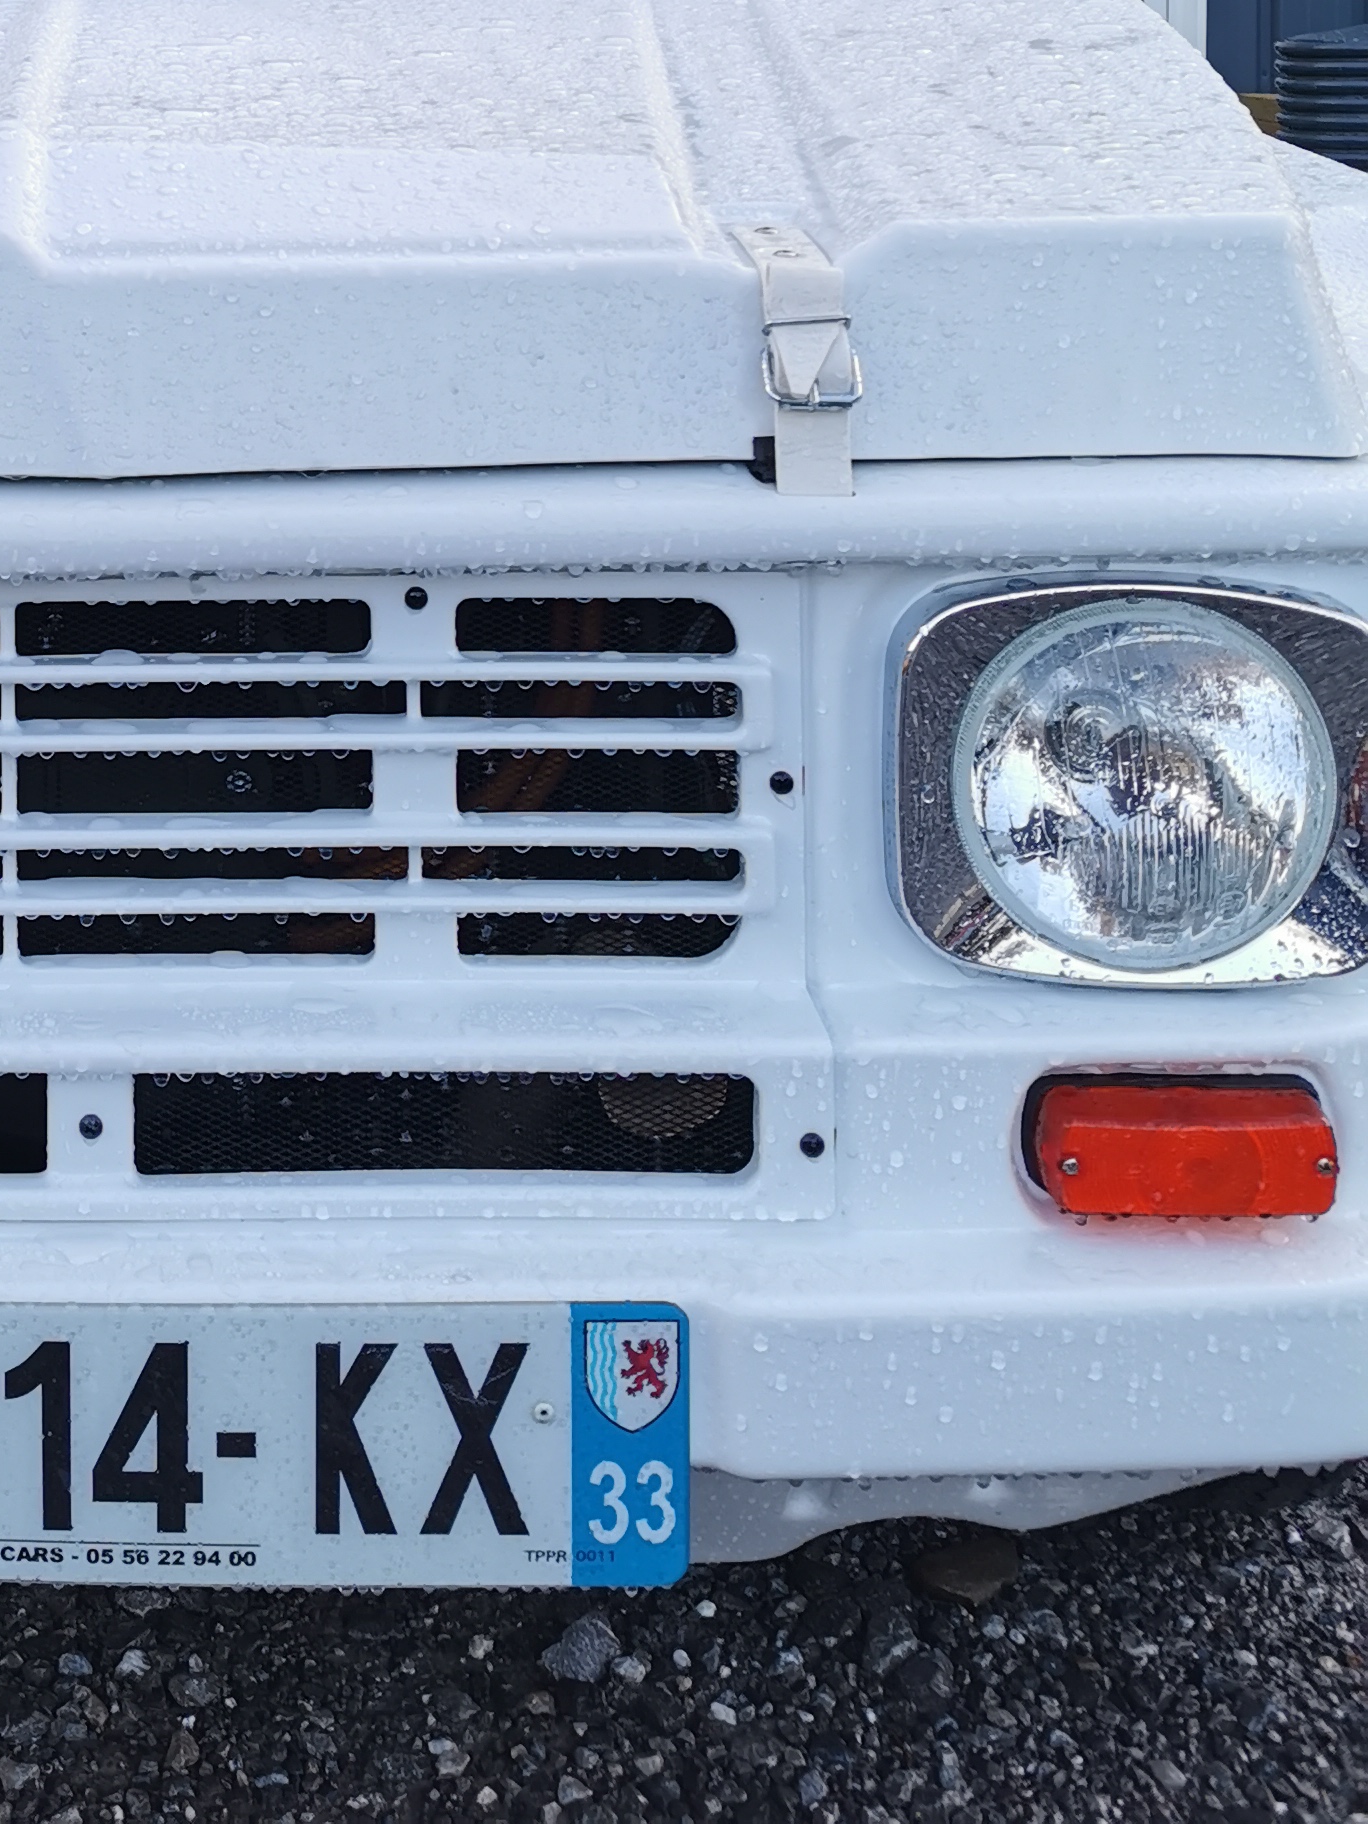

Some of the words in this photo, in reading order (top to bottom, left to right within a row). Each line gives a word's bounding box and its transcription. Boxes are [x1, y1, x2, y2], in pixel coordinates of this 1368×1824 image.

[588, 1460, 677, 1545] 33
[0, 1545, 65, 1564] CARS
[86, 1548, 114, 1565] 05
[122, 1548, 150, 1566] 56
[157, 1549, 186, 1566] 22
[193, 1550, 222, 1567] 94
[228, 1550, 257, 1567] 00
[524, 1549, 568, 1564] TPPR
